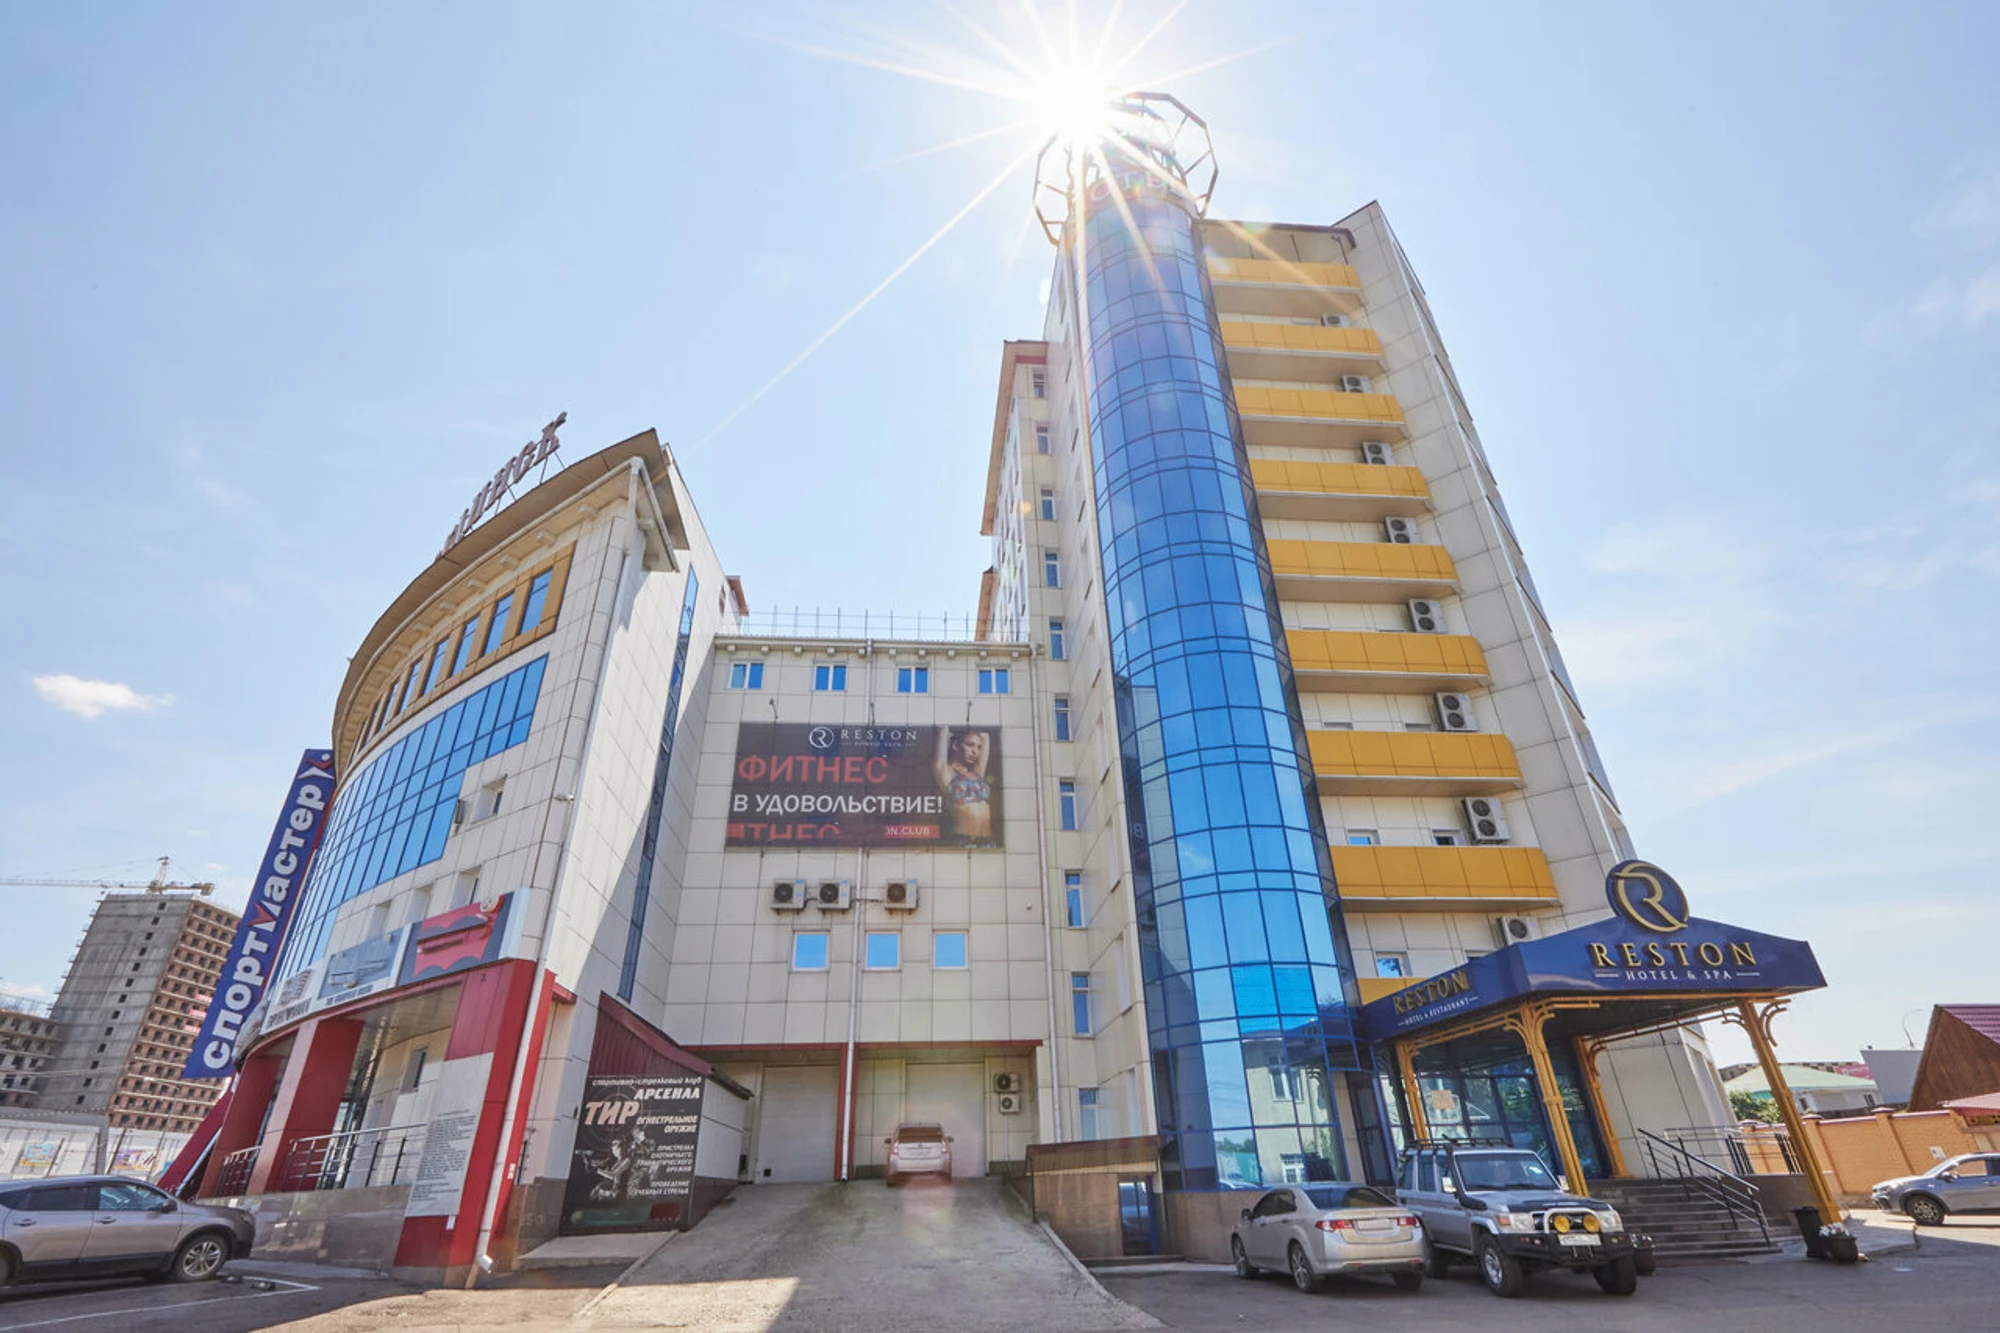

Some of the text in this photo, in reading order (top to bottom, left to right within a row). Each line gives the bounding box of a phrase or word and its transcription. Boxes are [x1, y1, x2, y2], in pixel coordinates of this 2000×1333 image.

[840, 729, 917, 740] RESTON
[737, 754, 889, 784] ФИТНЕС
[733, 794, 944, 815] В УДОВОЛЬСТВИЕ!
[1590, 942, 1758, 967] RESTON
[1625, 970, 1733, 980] HOTEL & SPA
[1392, 970, 1470, 1015] RESTON
[1404, 1013, 1423, 1025] HOTEL
[633, 1087, 700, 1100] АРСЕНАЛ
[584, 1100, 640, 1126] ТИР
[635, 1115, 698, 1125] ОГНЕСТРЕЛЬНОЕ
[663, 1124, 697, 1133] ОРУЖИЕ
